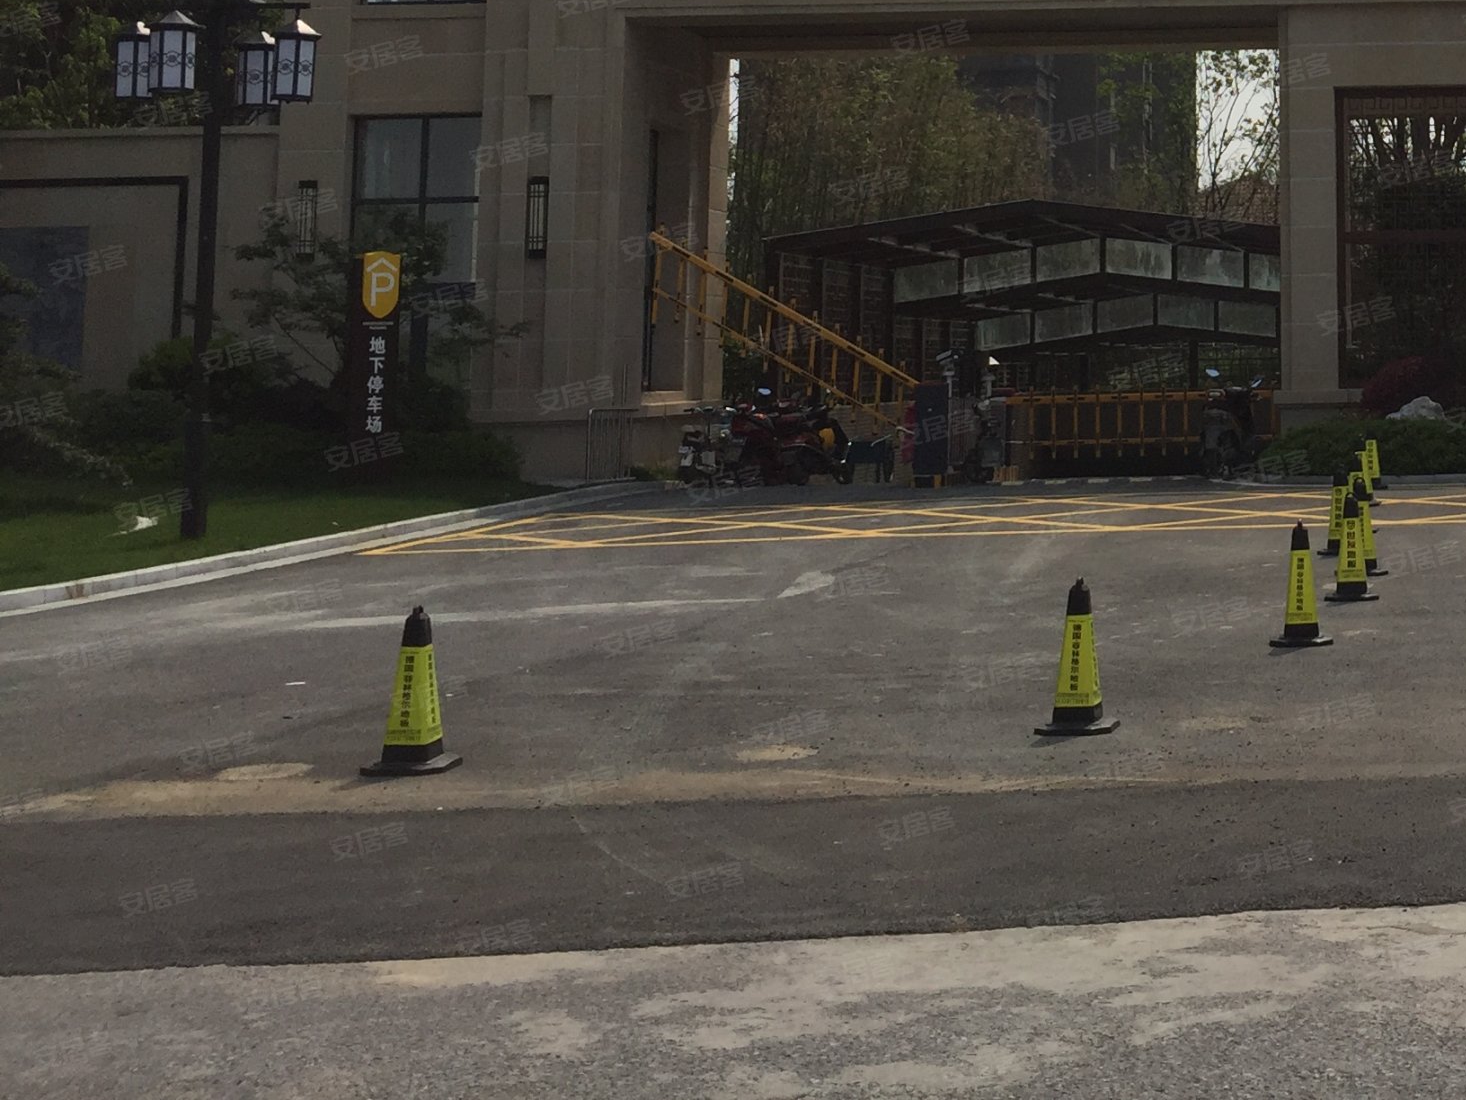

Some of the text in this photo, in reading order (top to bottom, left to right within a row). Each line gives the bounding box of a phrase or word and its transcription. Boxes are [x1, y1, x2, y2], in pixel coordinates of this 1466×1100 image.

[370, 272, 395, 307] P
[365, 336, 387, 433] 地下停车场
